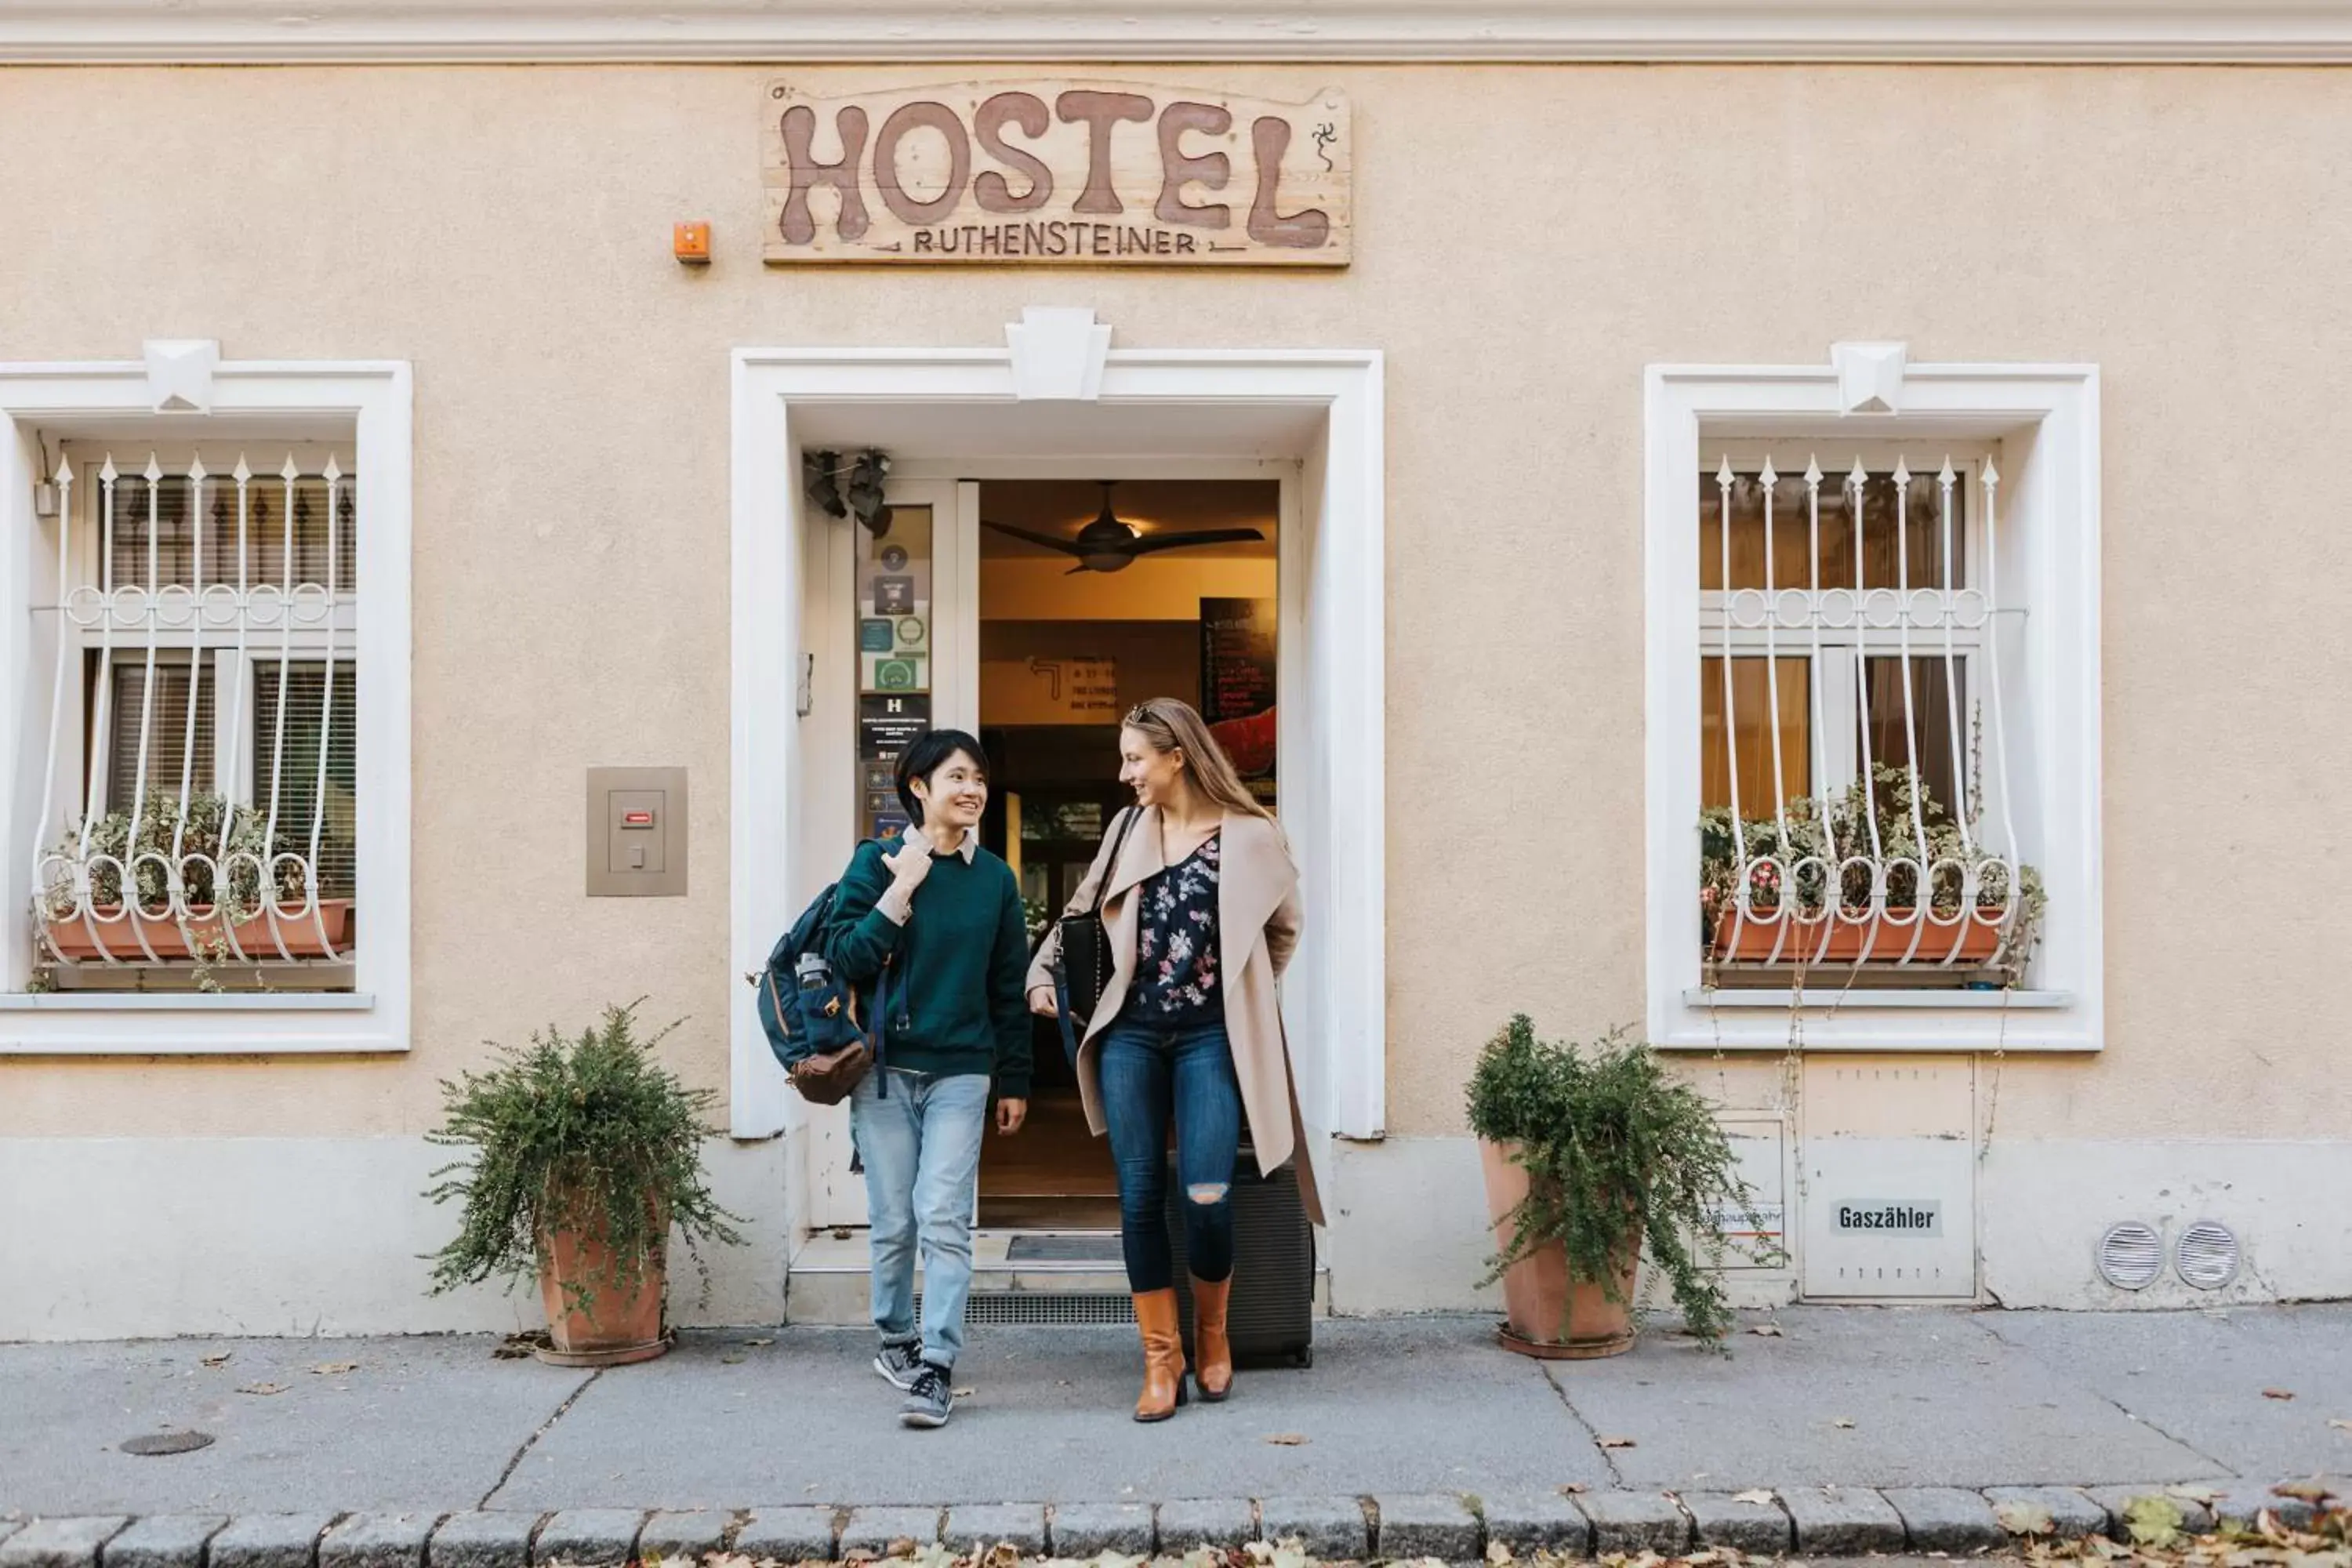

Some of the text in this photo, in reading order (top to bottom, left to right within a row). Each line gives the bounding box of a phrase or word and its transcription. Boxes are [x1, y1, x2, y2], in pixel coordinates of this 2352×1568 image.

[780, 90, 1330, 249] HOSTEL
[914, 221, 1196, 255] RUTHENSTEINER
[1840, 1207, 1934, 1229] Gaszähler
